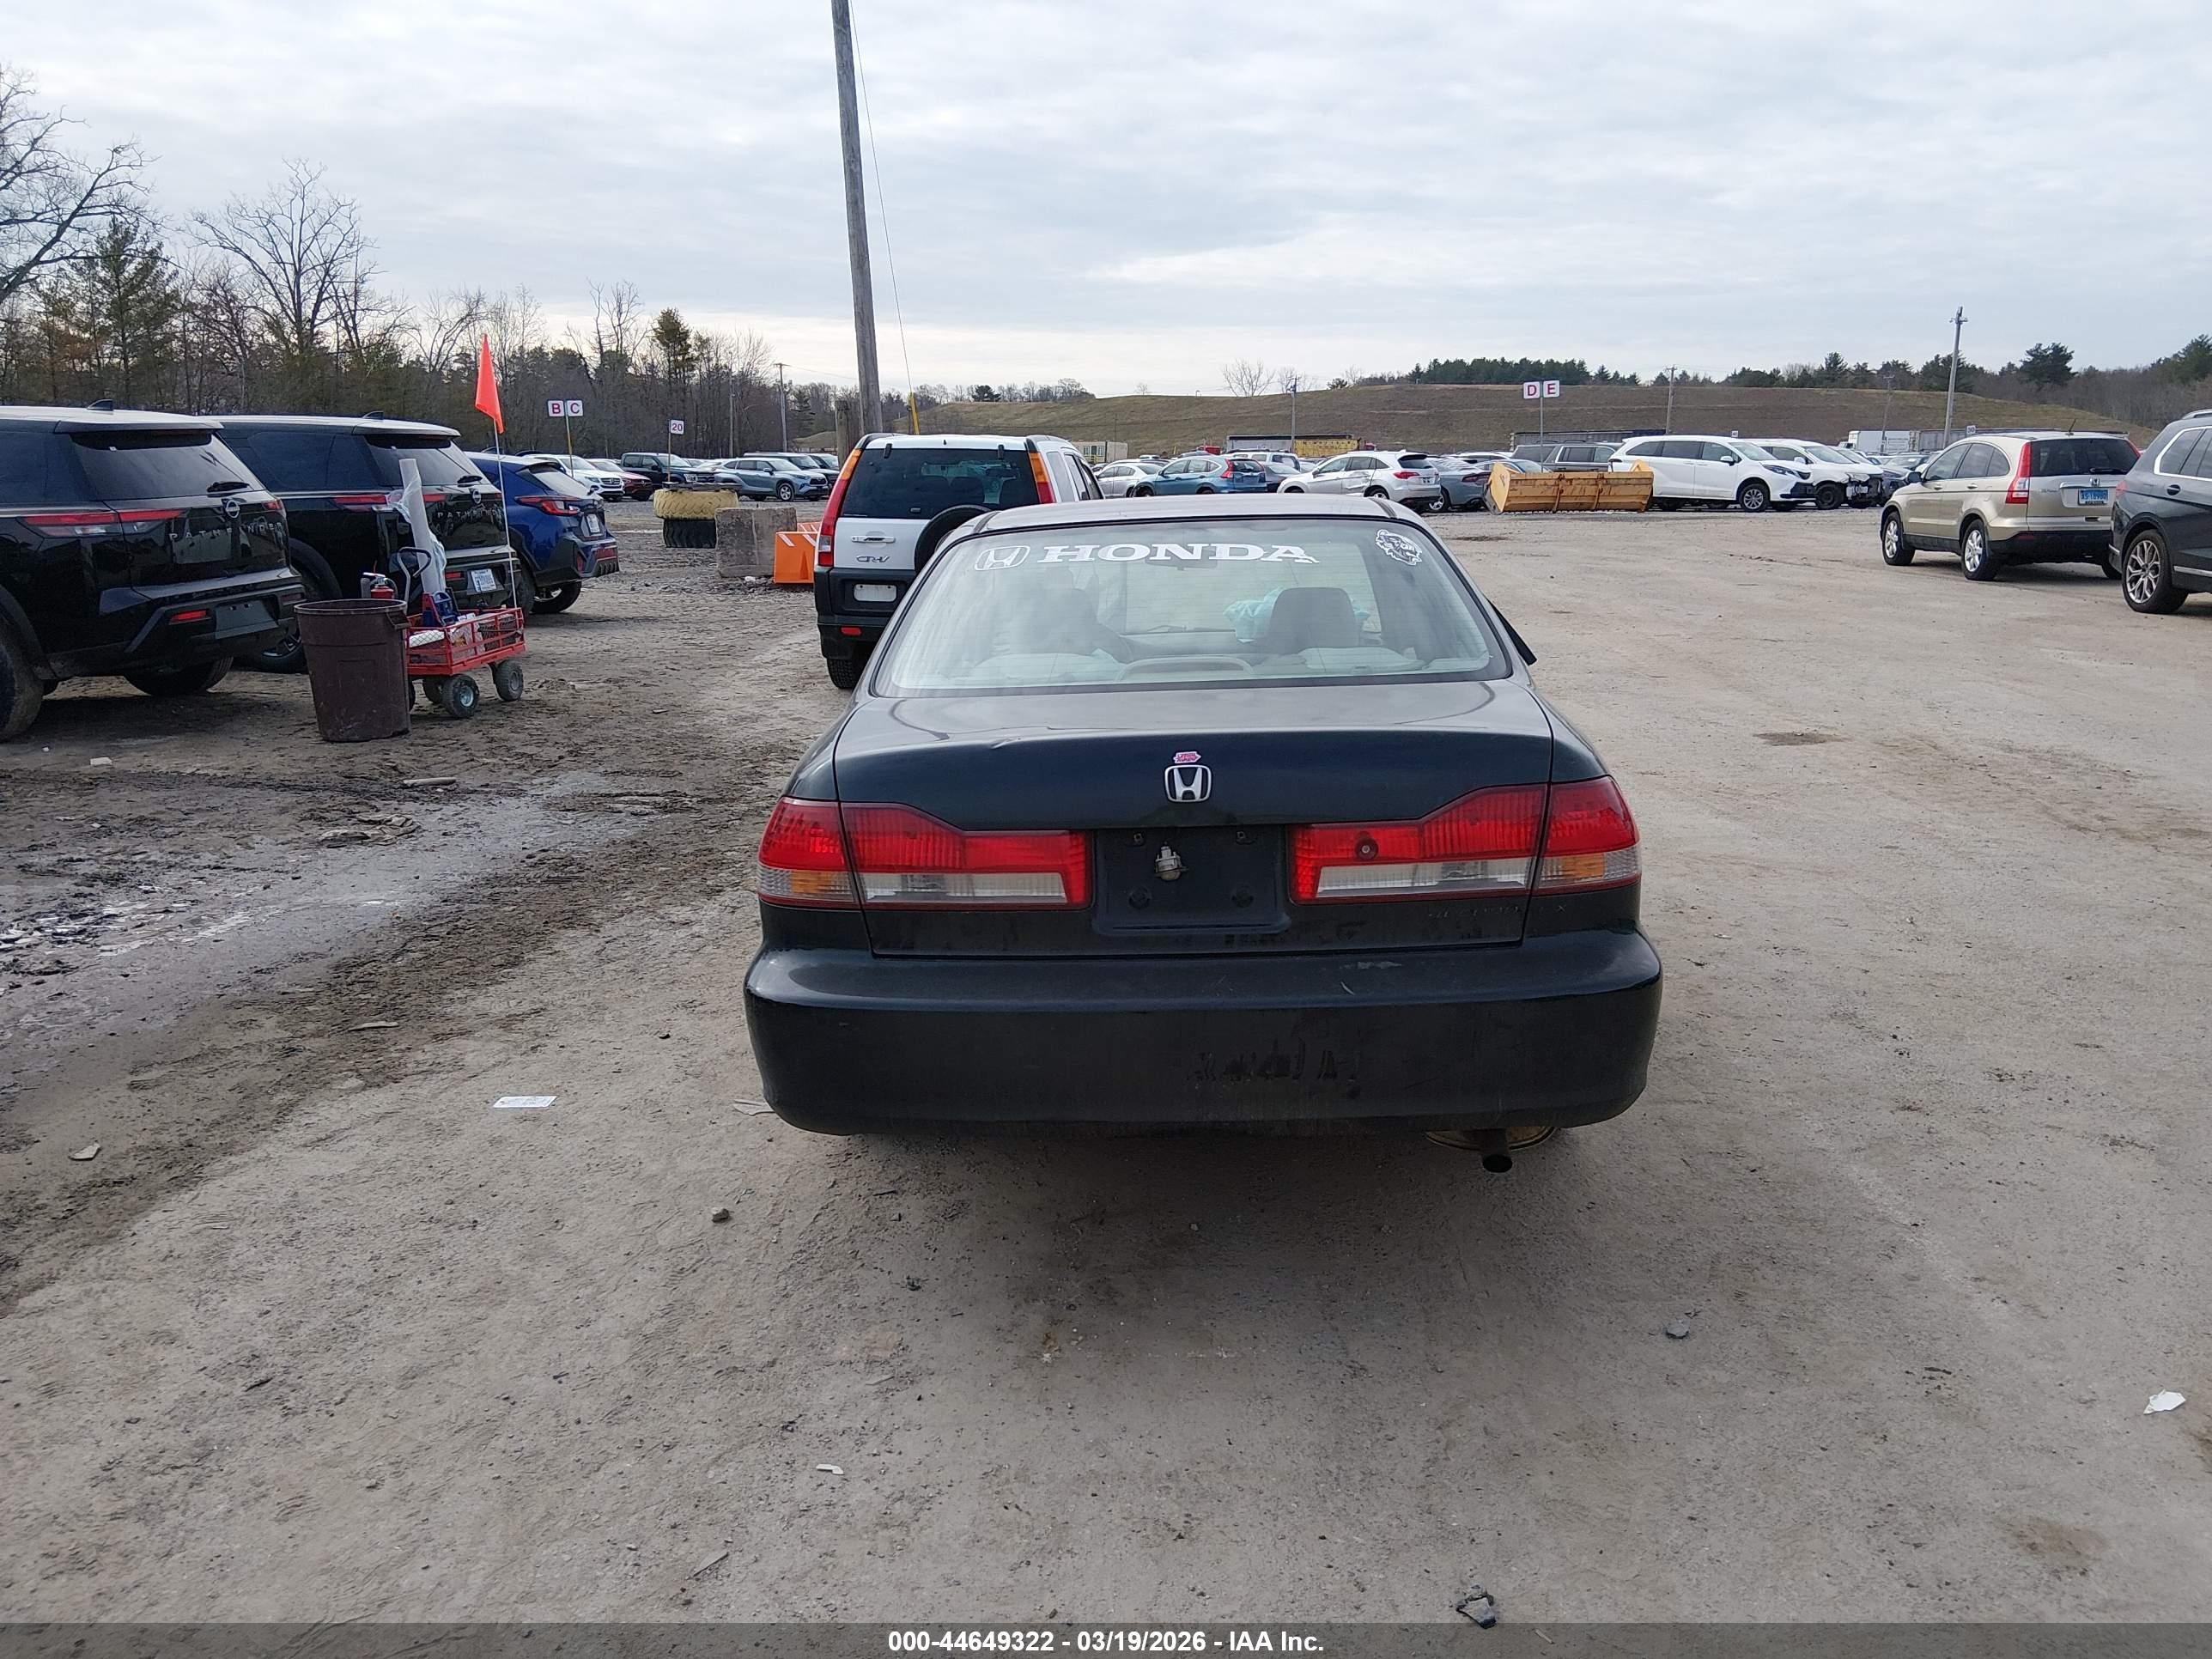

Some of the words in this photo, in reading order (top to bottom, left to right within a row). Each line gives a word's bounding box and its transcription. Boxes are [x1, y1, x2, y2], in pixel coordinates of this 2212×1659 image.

[1527, 384, 1537, 396] D
[1547, 383, 1557, 395] E
[551, 403, 561, 414] B
[570, 403, 580, 414] C
[672, 423, 683, 432] 20
[1036, 544, 1320, 563] HONDA
